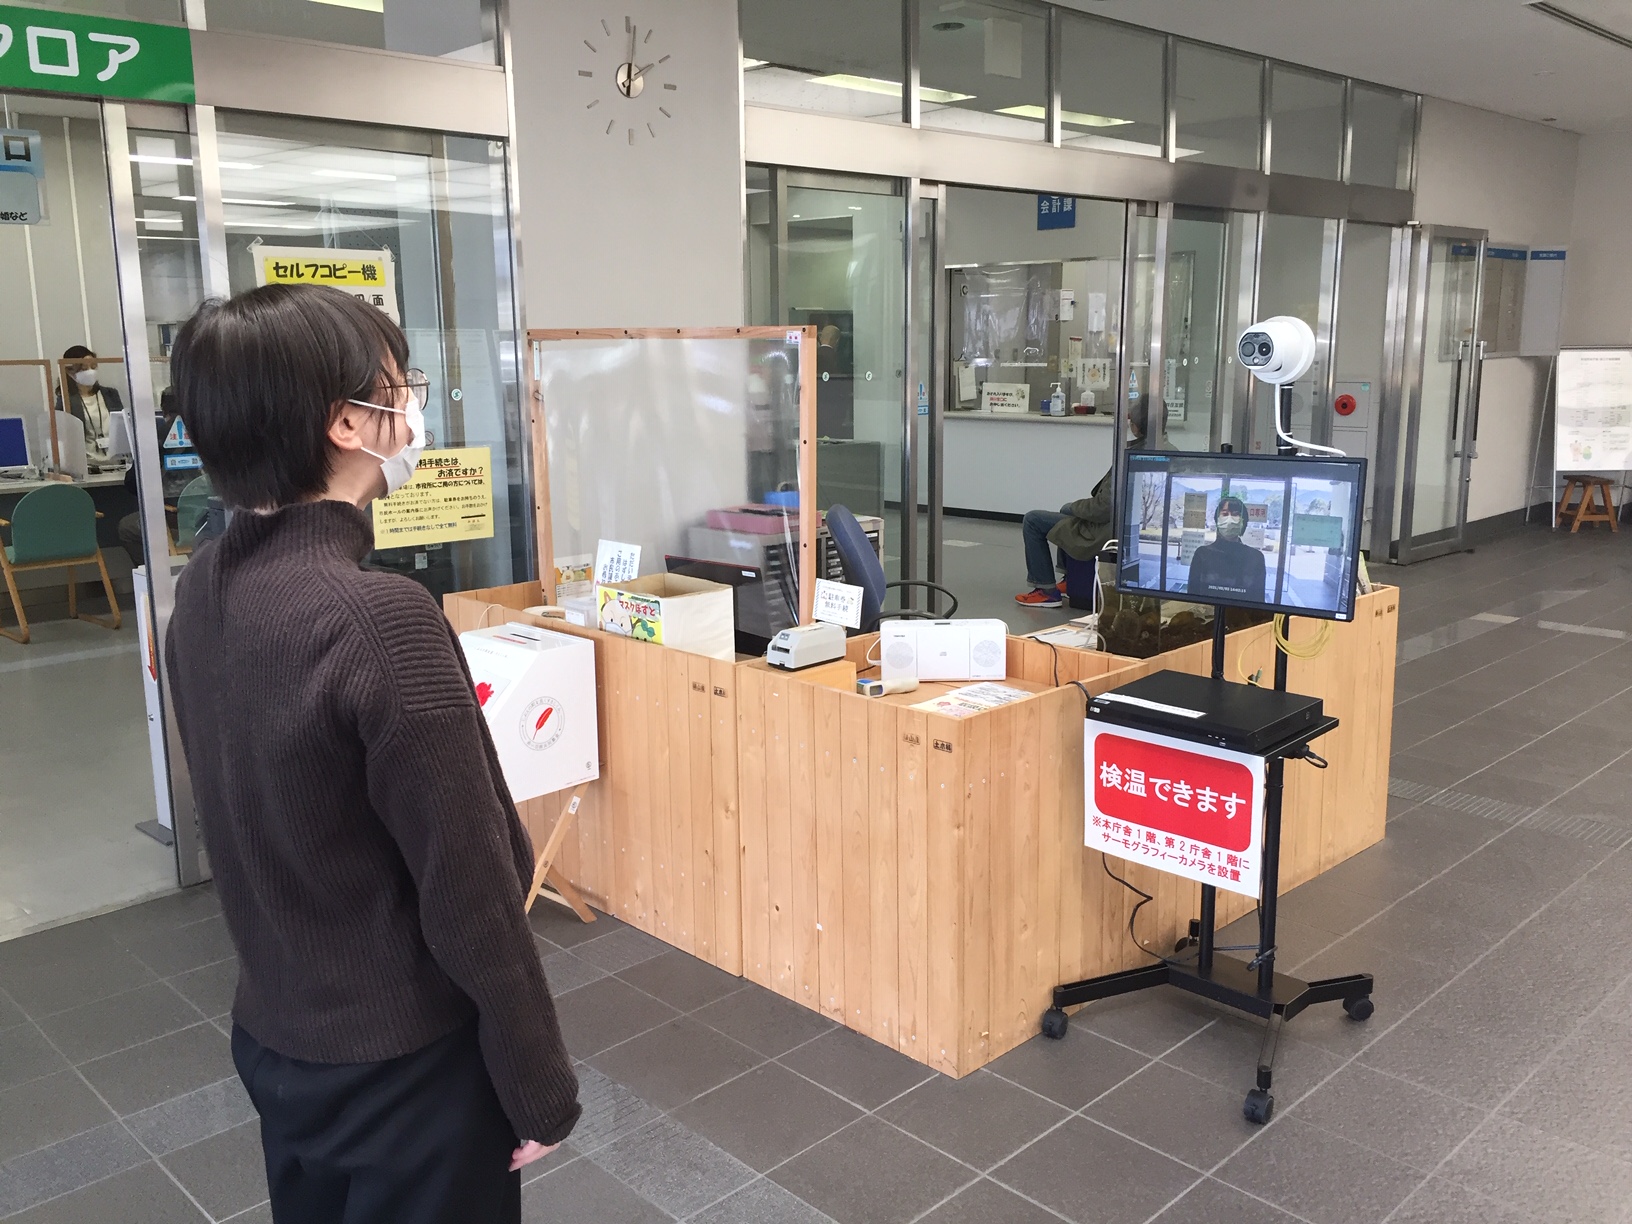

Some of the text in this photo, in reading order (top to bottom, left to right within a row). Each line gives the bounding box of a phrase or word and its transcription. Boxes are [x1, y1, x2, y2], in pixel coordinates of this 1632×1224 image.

[0, 24, 140, 82] ロア
[1041, 197, 1073, 214] 会計課
[273, 262, 378, 281] セルフコピー機
[416, 457, 461, 468] 料手続きは、
[437, 466, 484, 478] お済ですか？
[1099, 761, 1246, 820] 検温できます
[1102, 832, 1241, 882] サーモグラフィーカメラを設置
